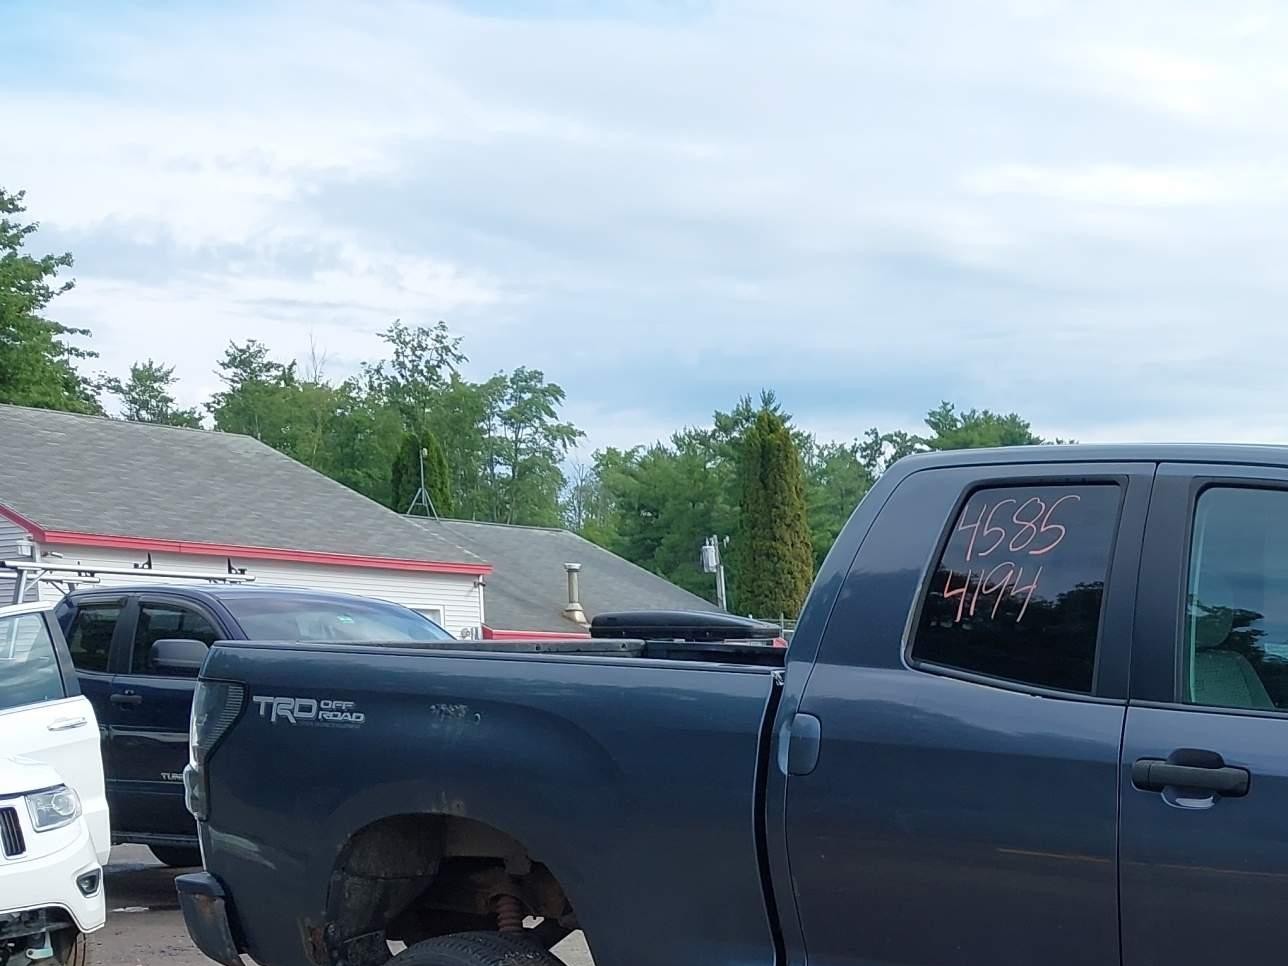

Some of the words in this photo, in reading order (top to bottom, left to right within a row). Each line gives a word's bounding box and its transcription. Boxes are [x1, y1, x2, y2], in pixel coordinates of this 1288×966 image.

[957, 494, 1081, 562] 4585
[943, 561, 1043, 623] 4194
[252, 695, 317, 724] TRD
[318, 711, 366, 723] ROAD
[320, 699, 355, 710] OFF
